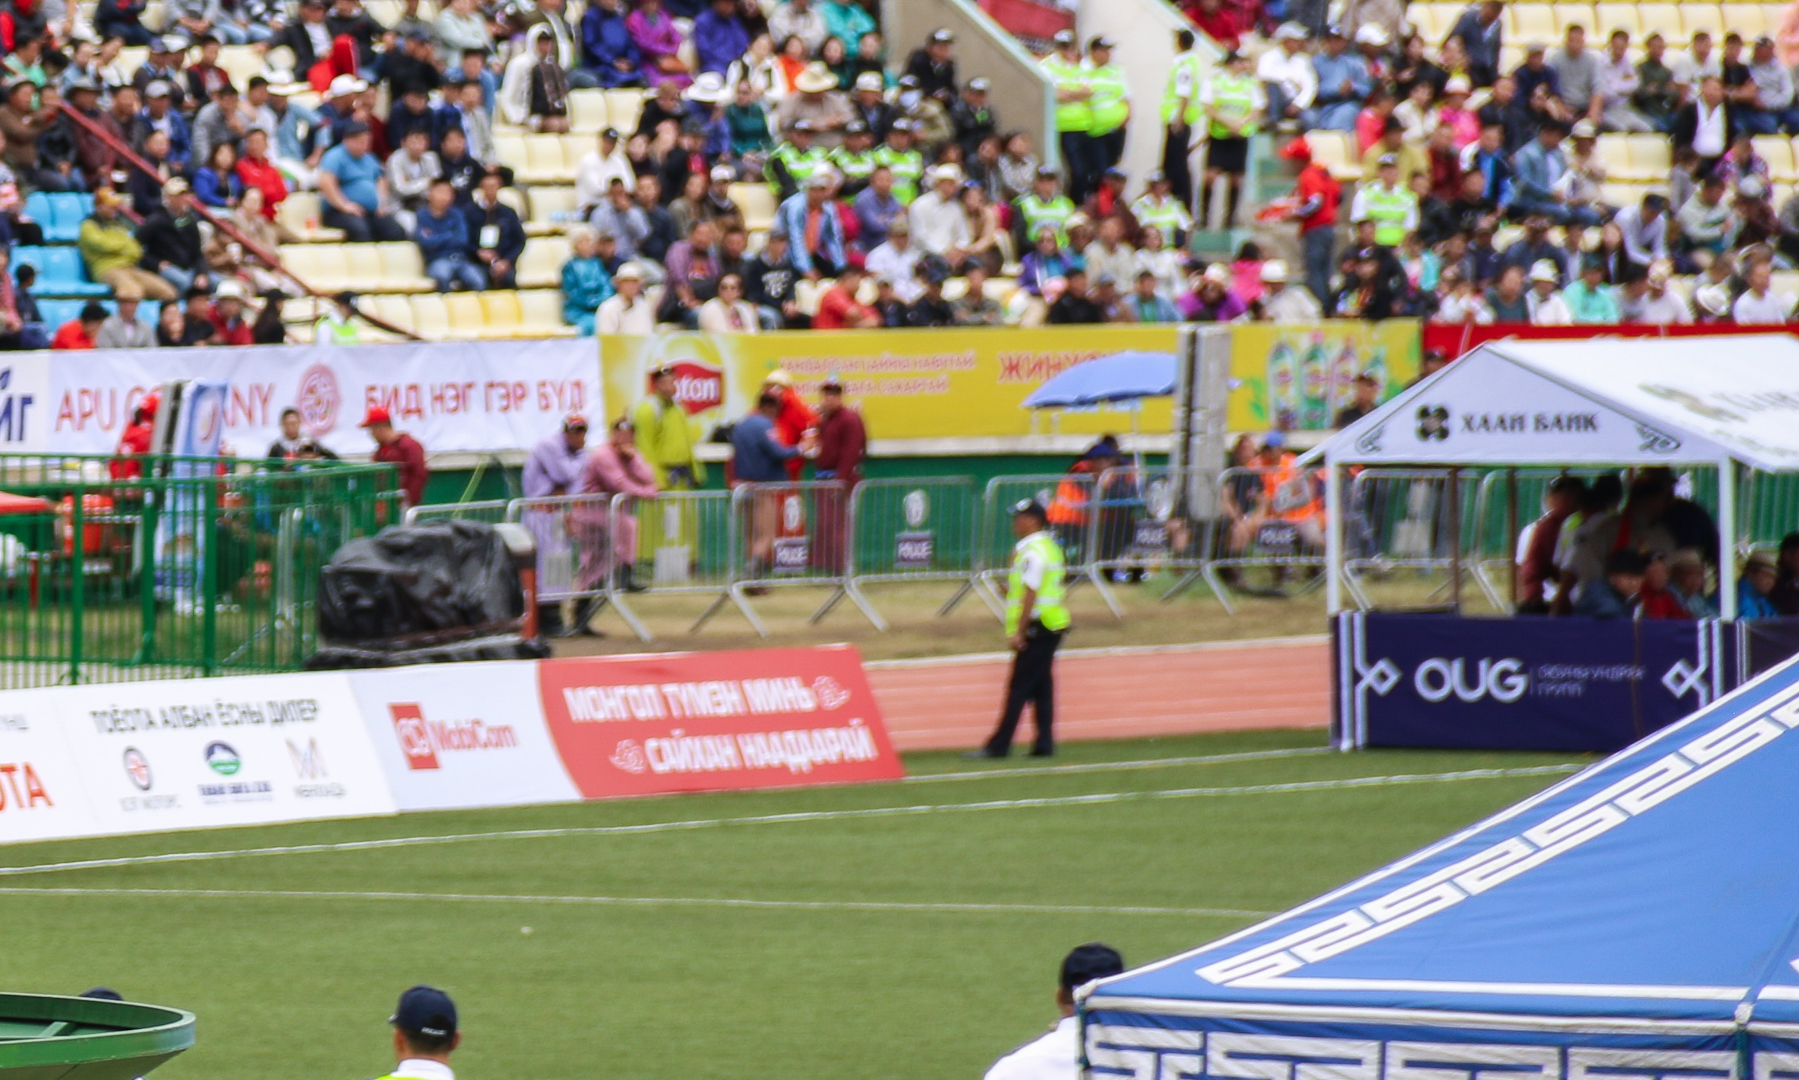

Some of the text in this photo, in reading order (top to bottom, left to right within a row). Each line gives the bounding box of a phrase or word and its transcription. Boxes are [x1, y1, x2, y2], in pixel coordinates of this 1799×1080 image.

[55, 387, 118, 433] APU
[430, 382, 475, 413] НЭГ
[484, 380, 527, 412] ГЭР
[1461, 411, 1600, 433] ХААН БАНК
[562, 684, 667, 723] МОНГОЛ
[742, 676, 818, 715] МИНЬ
[1414, 656, 1529, 703] OUG
[644, 728, 743, 773] САЙХАН
